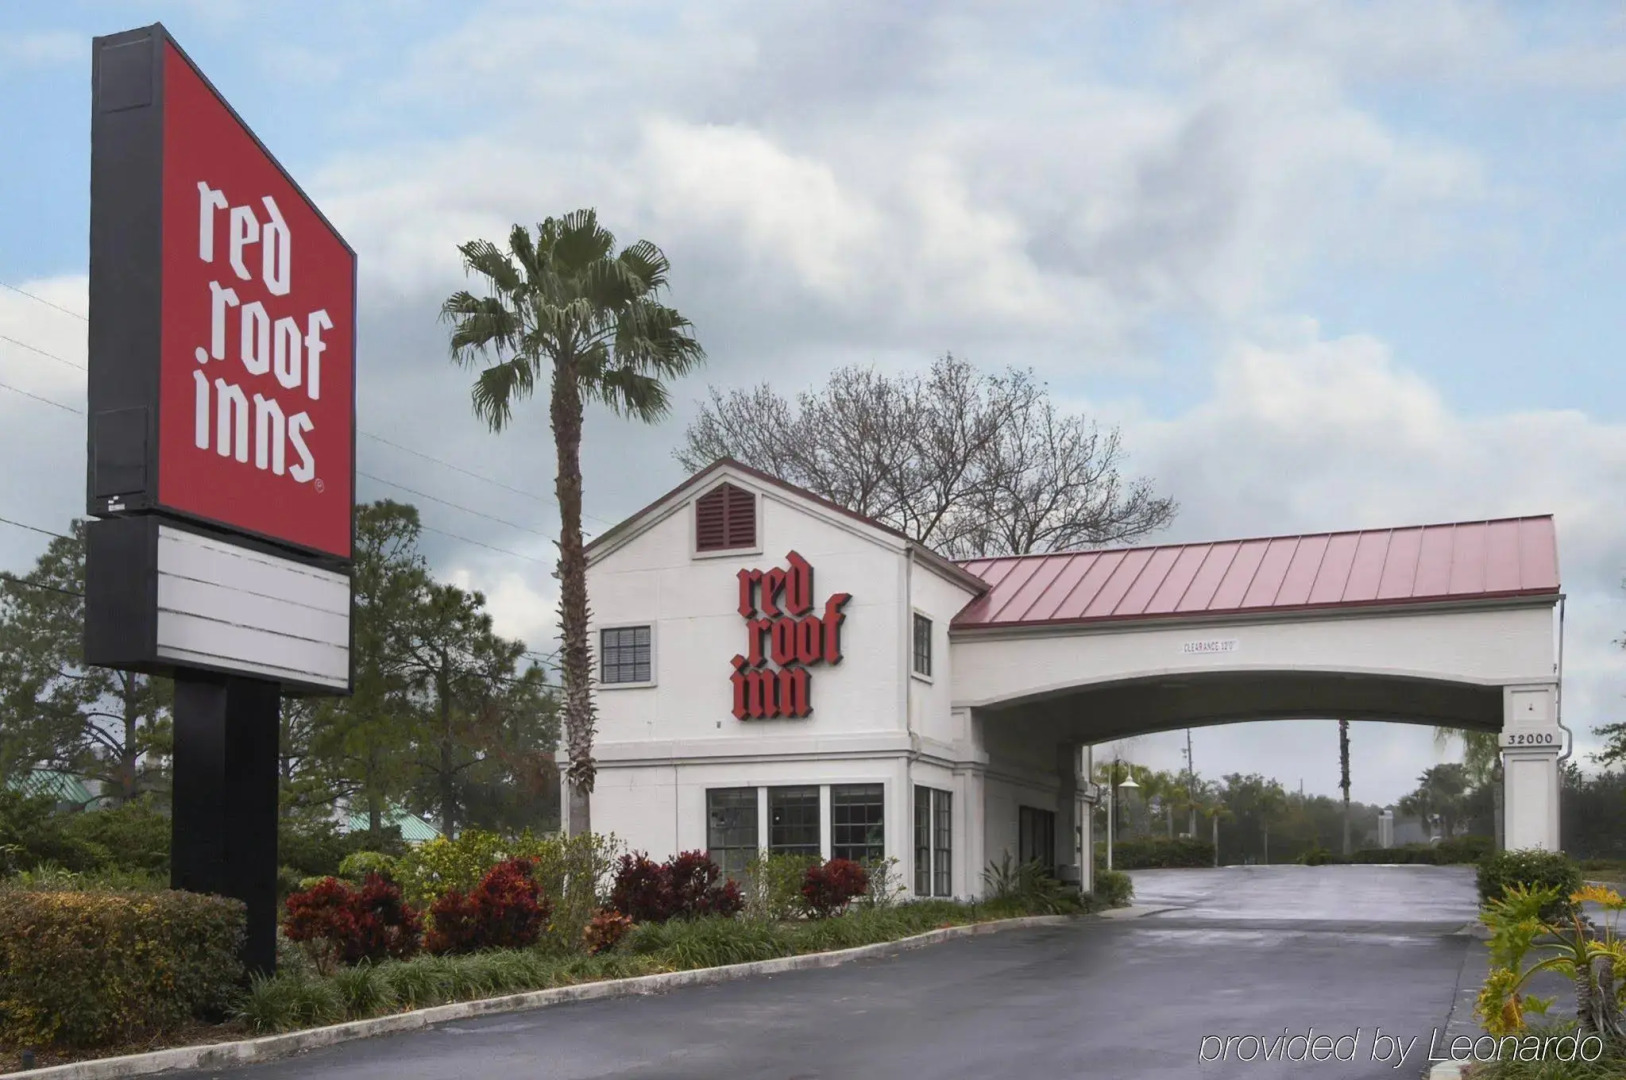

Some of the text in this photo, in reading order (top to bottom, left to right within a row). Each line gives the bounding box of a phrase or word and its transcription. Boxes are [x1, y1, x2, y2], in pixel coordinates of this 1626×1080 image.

[197, 181, 291, 296] red
[209, 280, 334, 400] roof
[193, 346, 315, 484] inns
[736, 550, 814, 618] red
[746, 593, 853, 668] roof
[1184, 641, 1218, 652] CLEARANCE
[730, 654, 814, 721] inn
[1508, 733, 1553, 745] 32000
